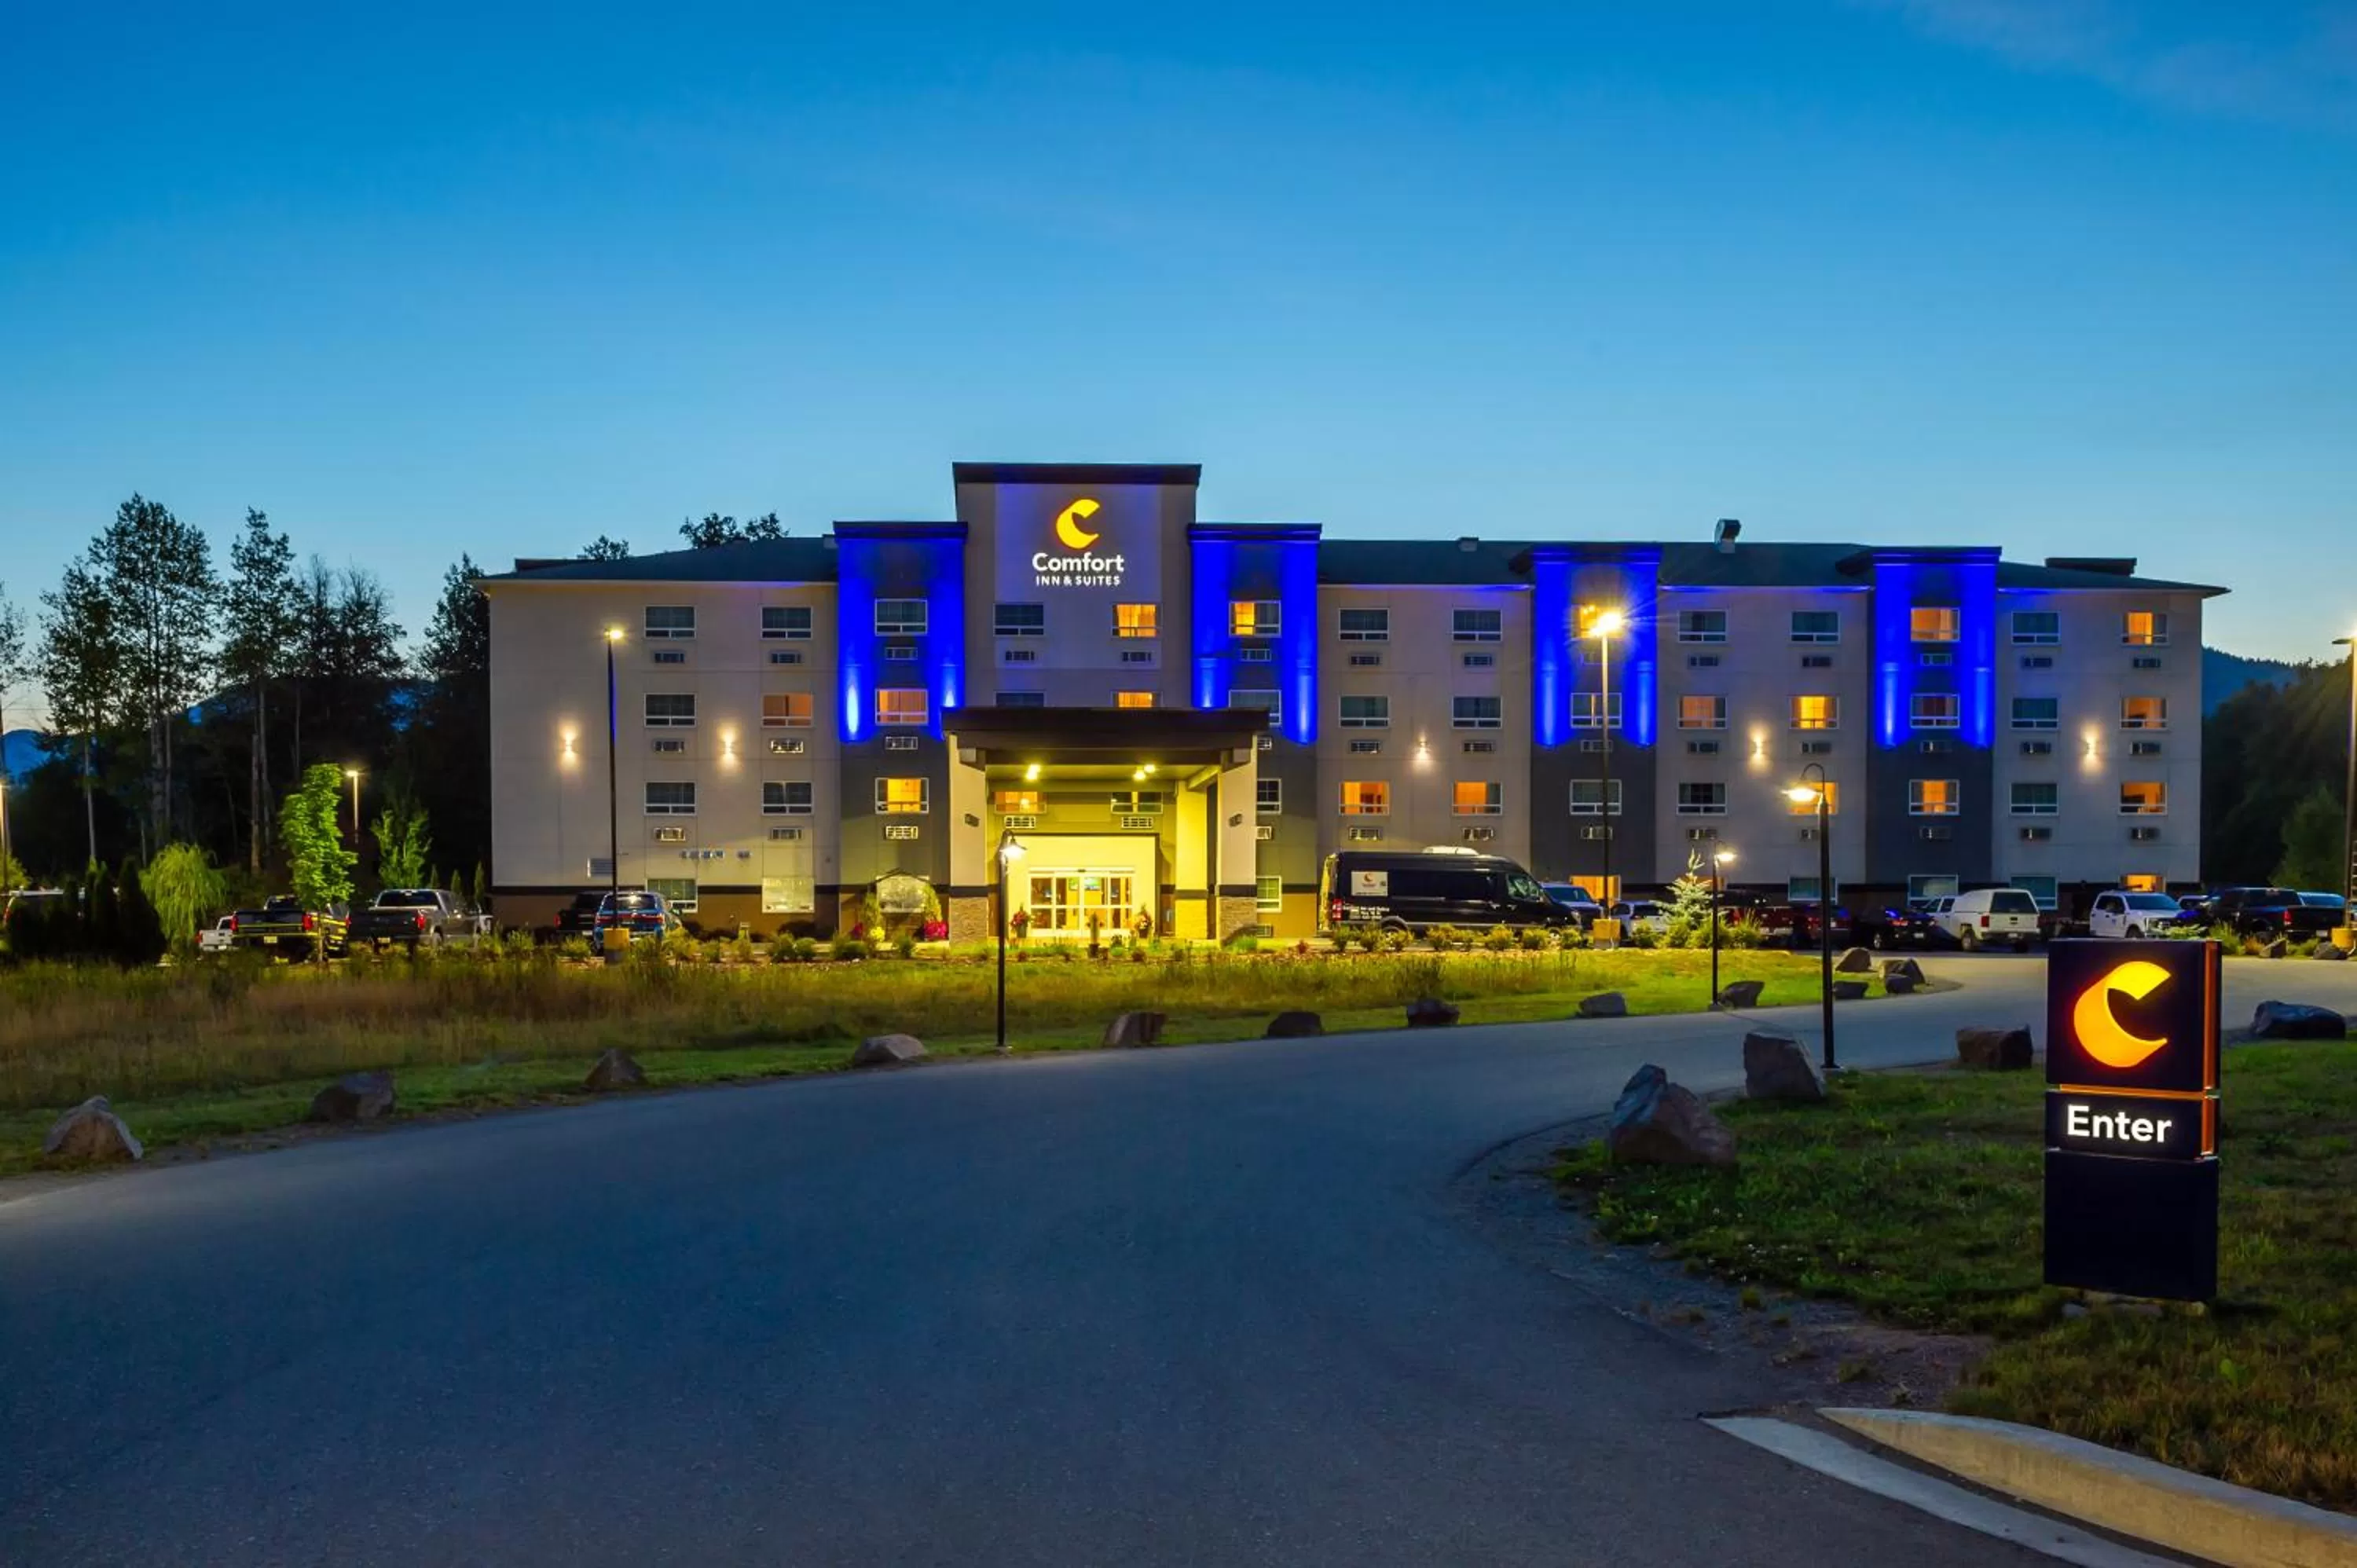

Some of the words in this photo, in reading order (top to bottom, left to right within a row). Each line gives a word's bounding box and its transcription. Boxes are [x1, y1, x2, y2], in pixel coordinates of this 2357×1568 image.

[1032, 551, 1124, 572] Comfort
[1036, 575, 1061, 586] INN
[1063, 574, 1072, 586] &
[1075, 575, 1120, 586] SUITES
[2067, 1104, 2172, 1143] Enter
